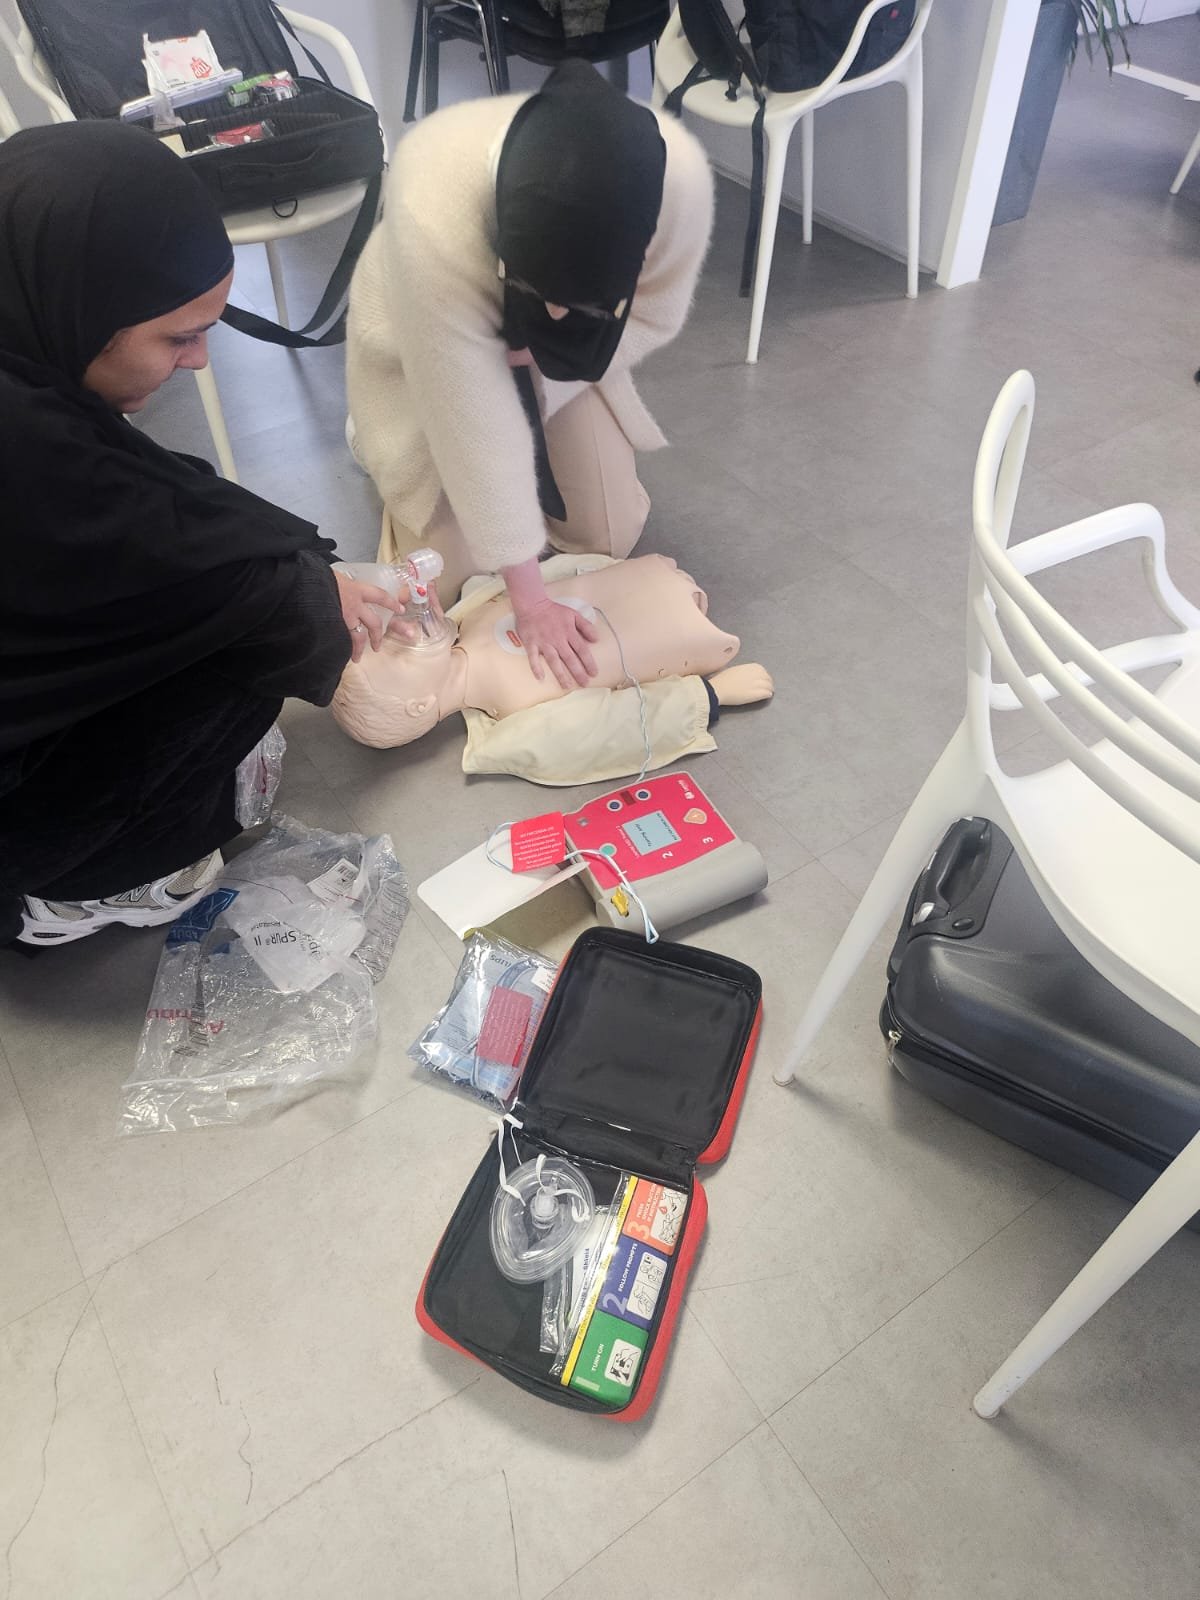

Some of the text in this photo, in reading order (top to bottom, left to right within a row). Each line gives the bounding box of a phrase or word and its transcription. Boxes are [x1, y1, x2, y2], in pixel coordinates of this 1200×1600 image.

[662, 851, 673, 859] 2
[627, 1221, 650, 1241] 3
[617, 1243, 638, 1292] FOLLOW PROMPTS
[602, 1292, 628, 1315] 2
[591, 1343, 605, 1372] TURN ON
